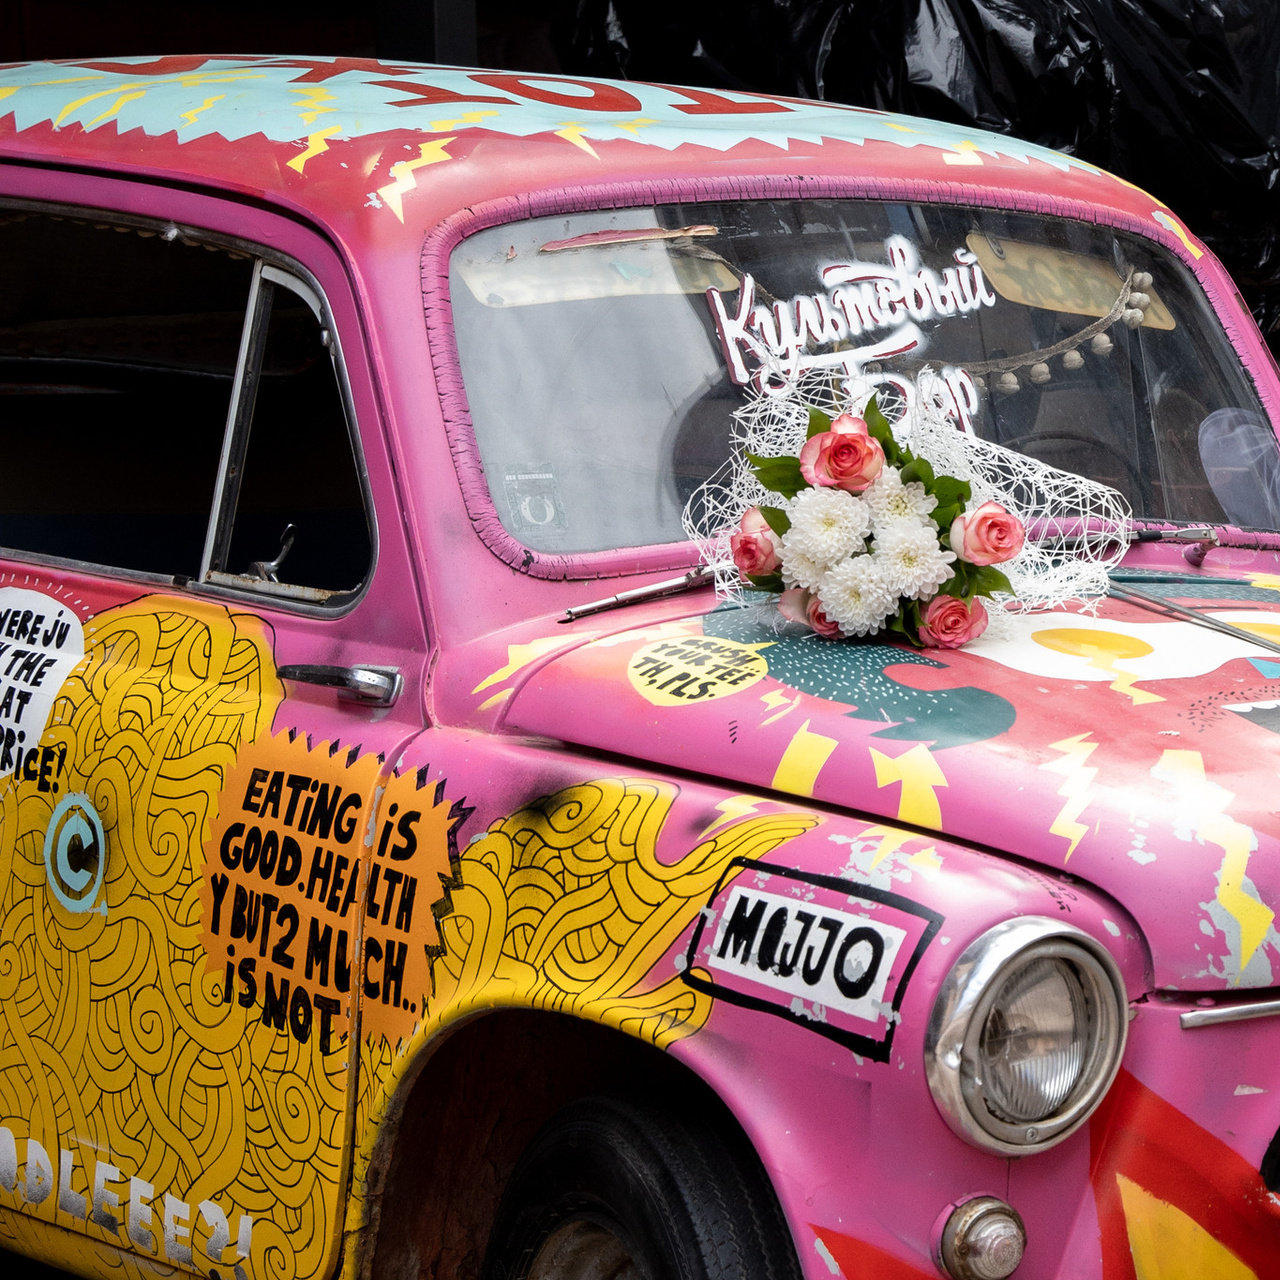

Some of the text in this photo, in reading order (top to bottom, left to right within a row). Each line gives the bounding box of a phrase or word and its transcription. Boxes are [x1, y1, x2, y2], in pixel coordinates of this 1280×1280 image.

[651, 643, 713, 666] YOUR
[3, 649, 57, 688] THE
[656, 672, 718, 699] PLS.
